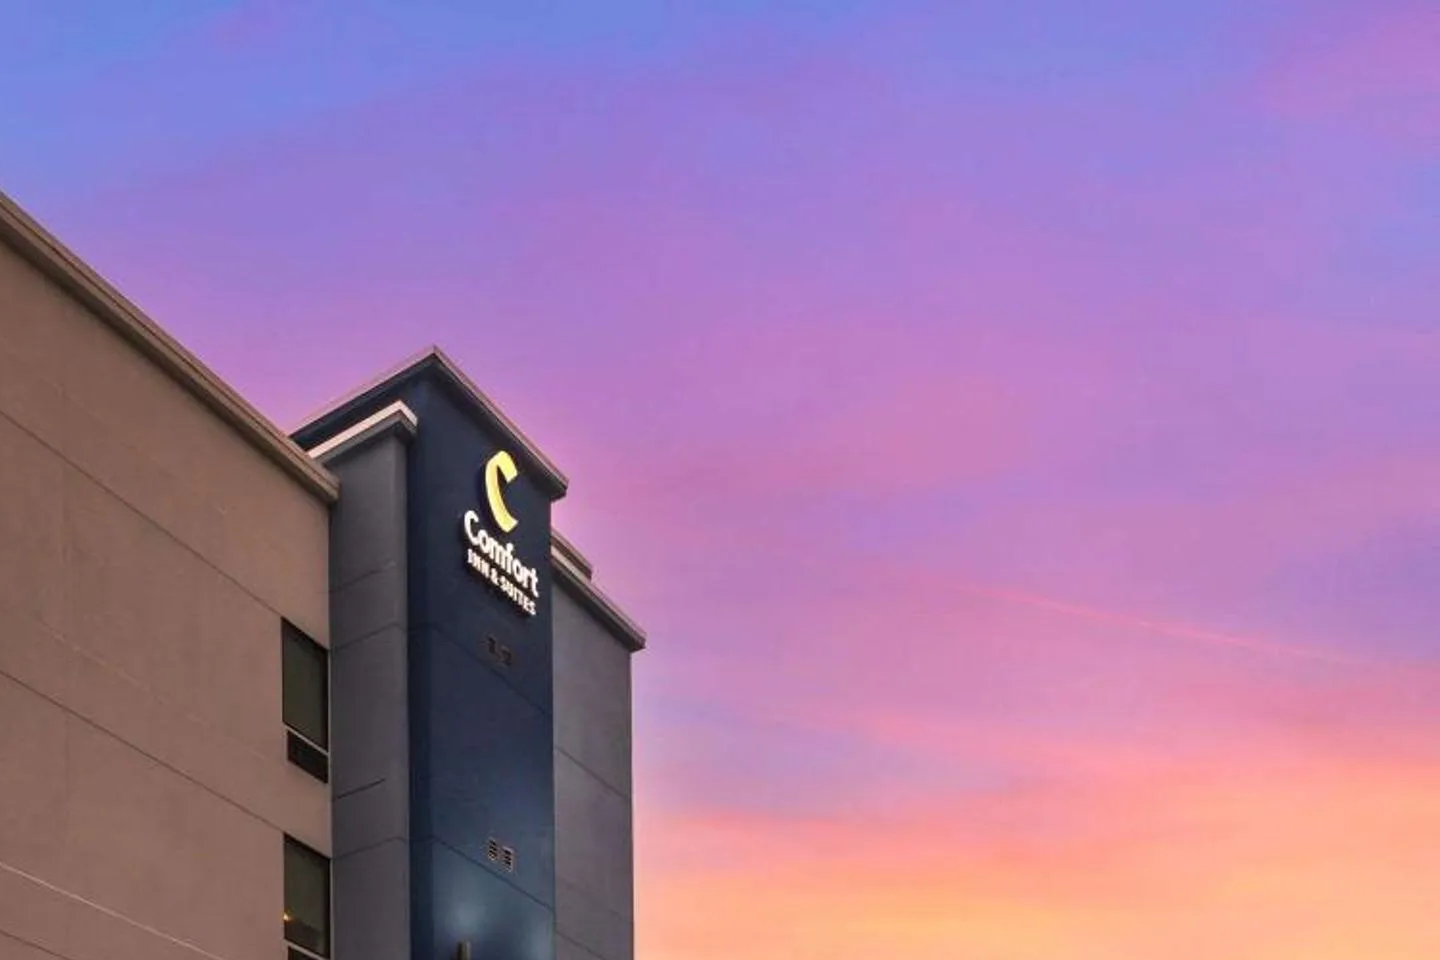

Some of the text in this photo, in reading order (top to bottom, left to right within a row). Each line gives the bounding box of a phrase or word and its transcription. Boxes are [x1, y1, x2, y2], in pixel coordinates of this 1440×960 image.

[464, 509, 539, 598] Comfort
[467, 548, 537, 616] INN & SUITES
